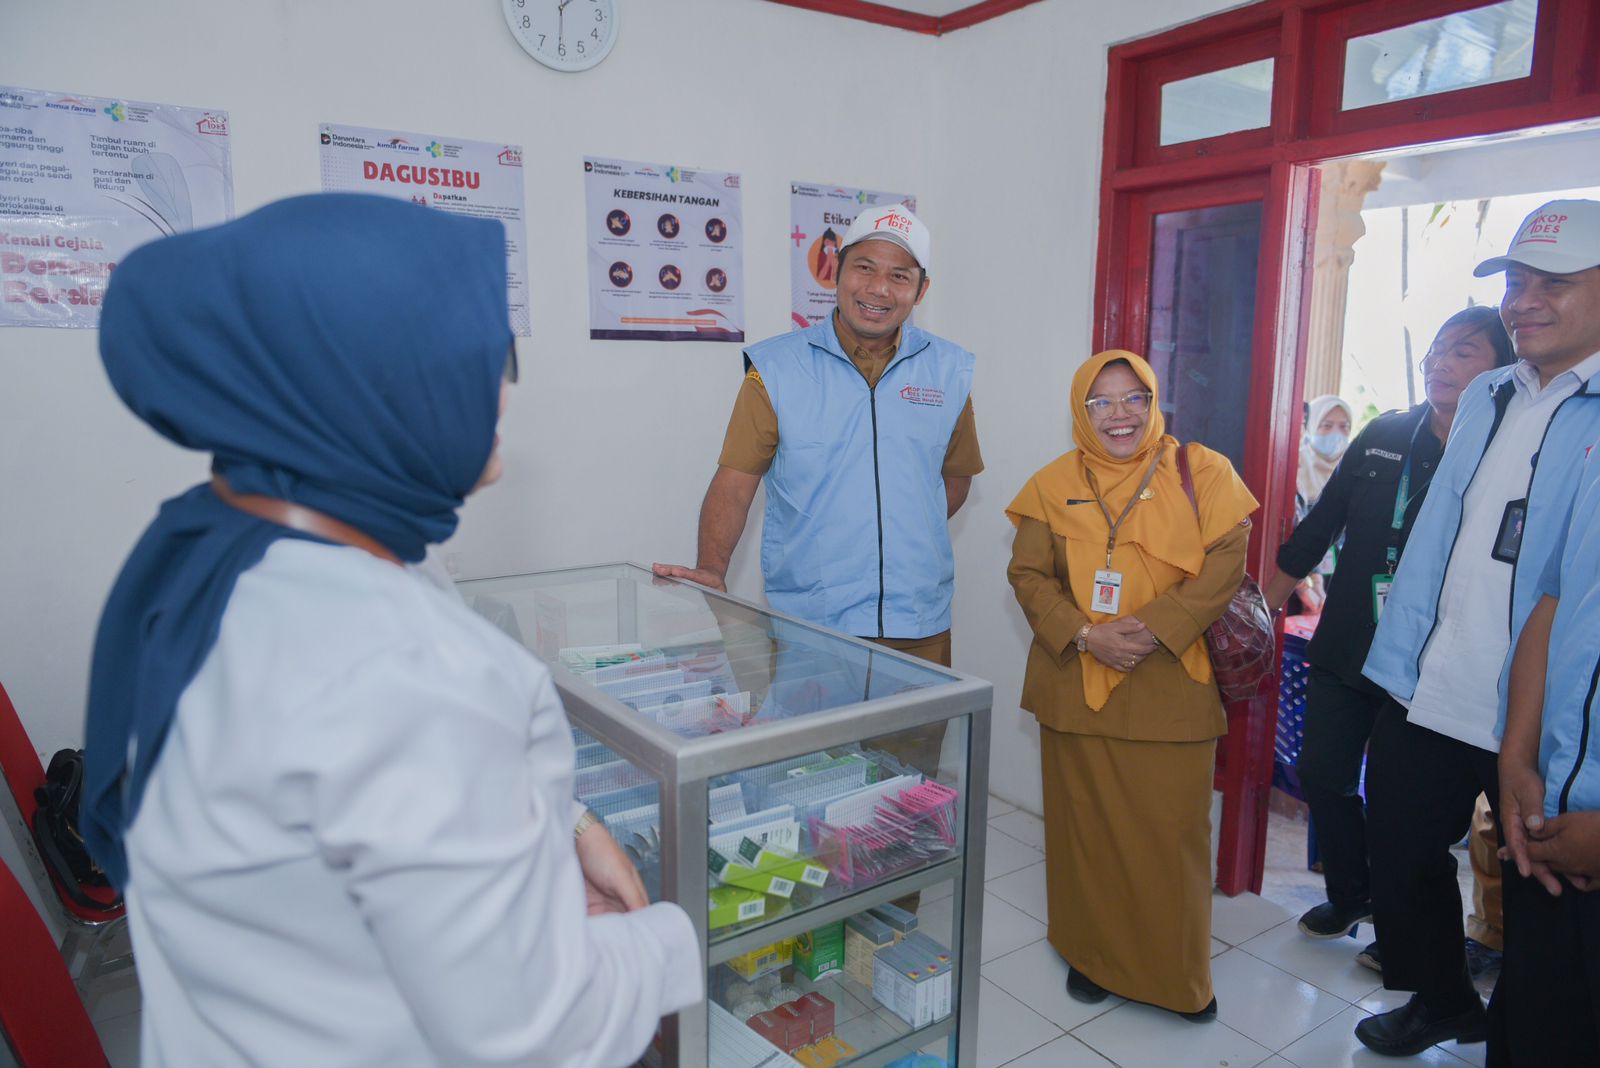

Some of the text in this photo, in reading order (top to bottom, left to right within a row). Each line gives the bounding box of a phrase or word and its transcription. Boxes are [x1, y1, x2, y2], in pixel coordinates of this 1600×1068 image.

[522, 15, 531, 28] 8
[595, 9, 603, 22] 3
[591, 28, 599, 40] 4
[538, 34, 546, 47] 7
[558, 43, 566, 57] 6
[577, 41, 585, 54] 5
[71, 104, 97, 113] farma
[28, 136, 46, 144] dan
[89, 134, 121, 144] Timbul
[123, 139, 147, 147] ruam
[332, 134, 366, 143] Danantara
[36, 144, 64, 154] tinggi
[91, 142, 149, 154] bagian tubuh
[332, 140, 364, 150] Indonesia
[19, 161, 38, 169] dan
[93, 168, 145, 179] Perdarahan
[363, 160, 480, 190] DAGUSIBU
[94, 183, 125, 193] hidung
[613, 188, 720, 208] KEBERSIHAN TANGAN
[823, 212, 852, 227] Etika
[893, 213, 913, 226] KOP
[1537, 214, 1568, 224] KOP
[891, 220, 910, 234] DES
[1534, 224, 1561, 234] DES
[0, 232, 51, 247] Kenali
